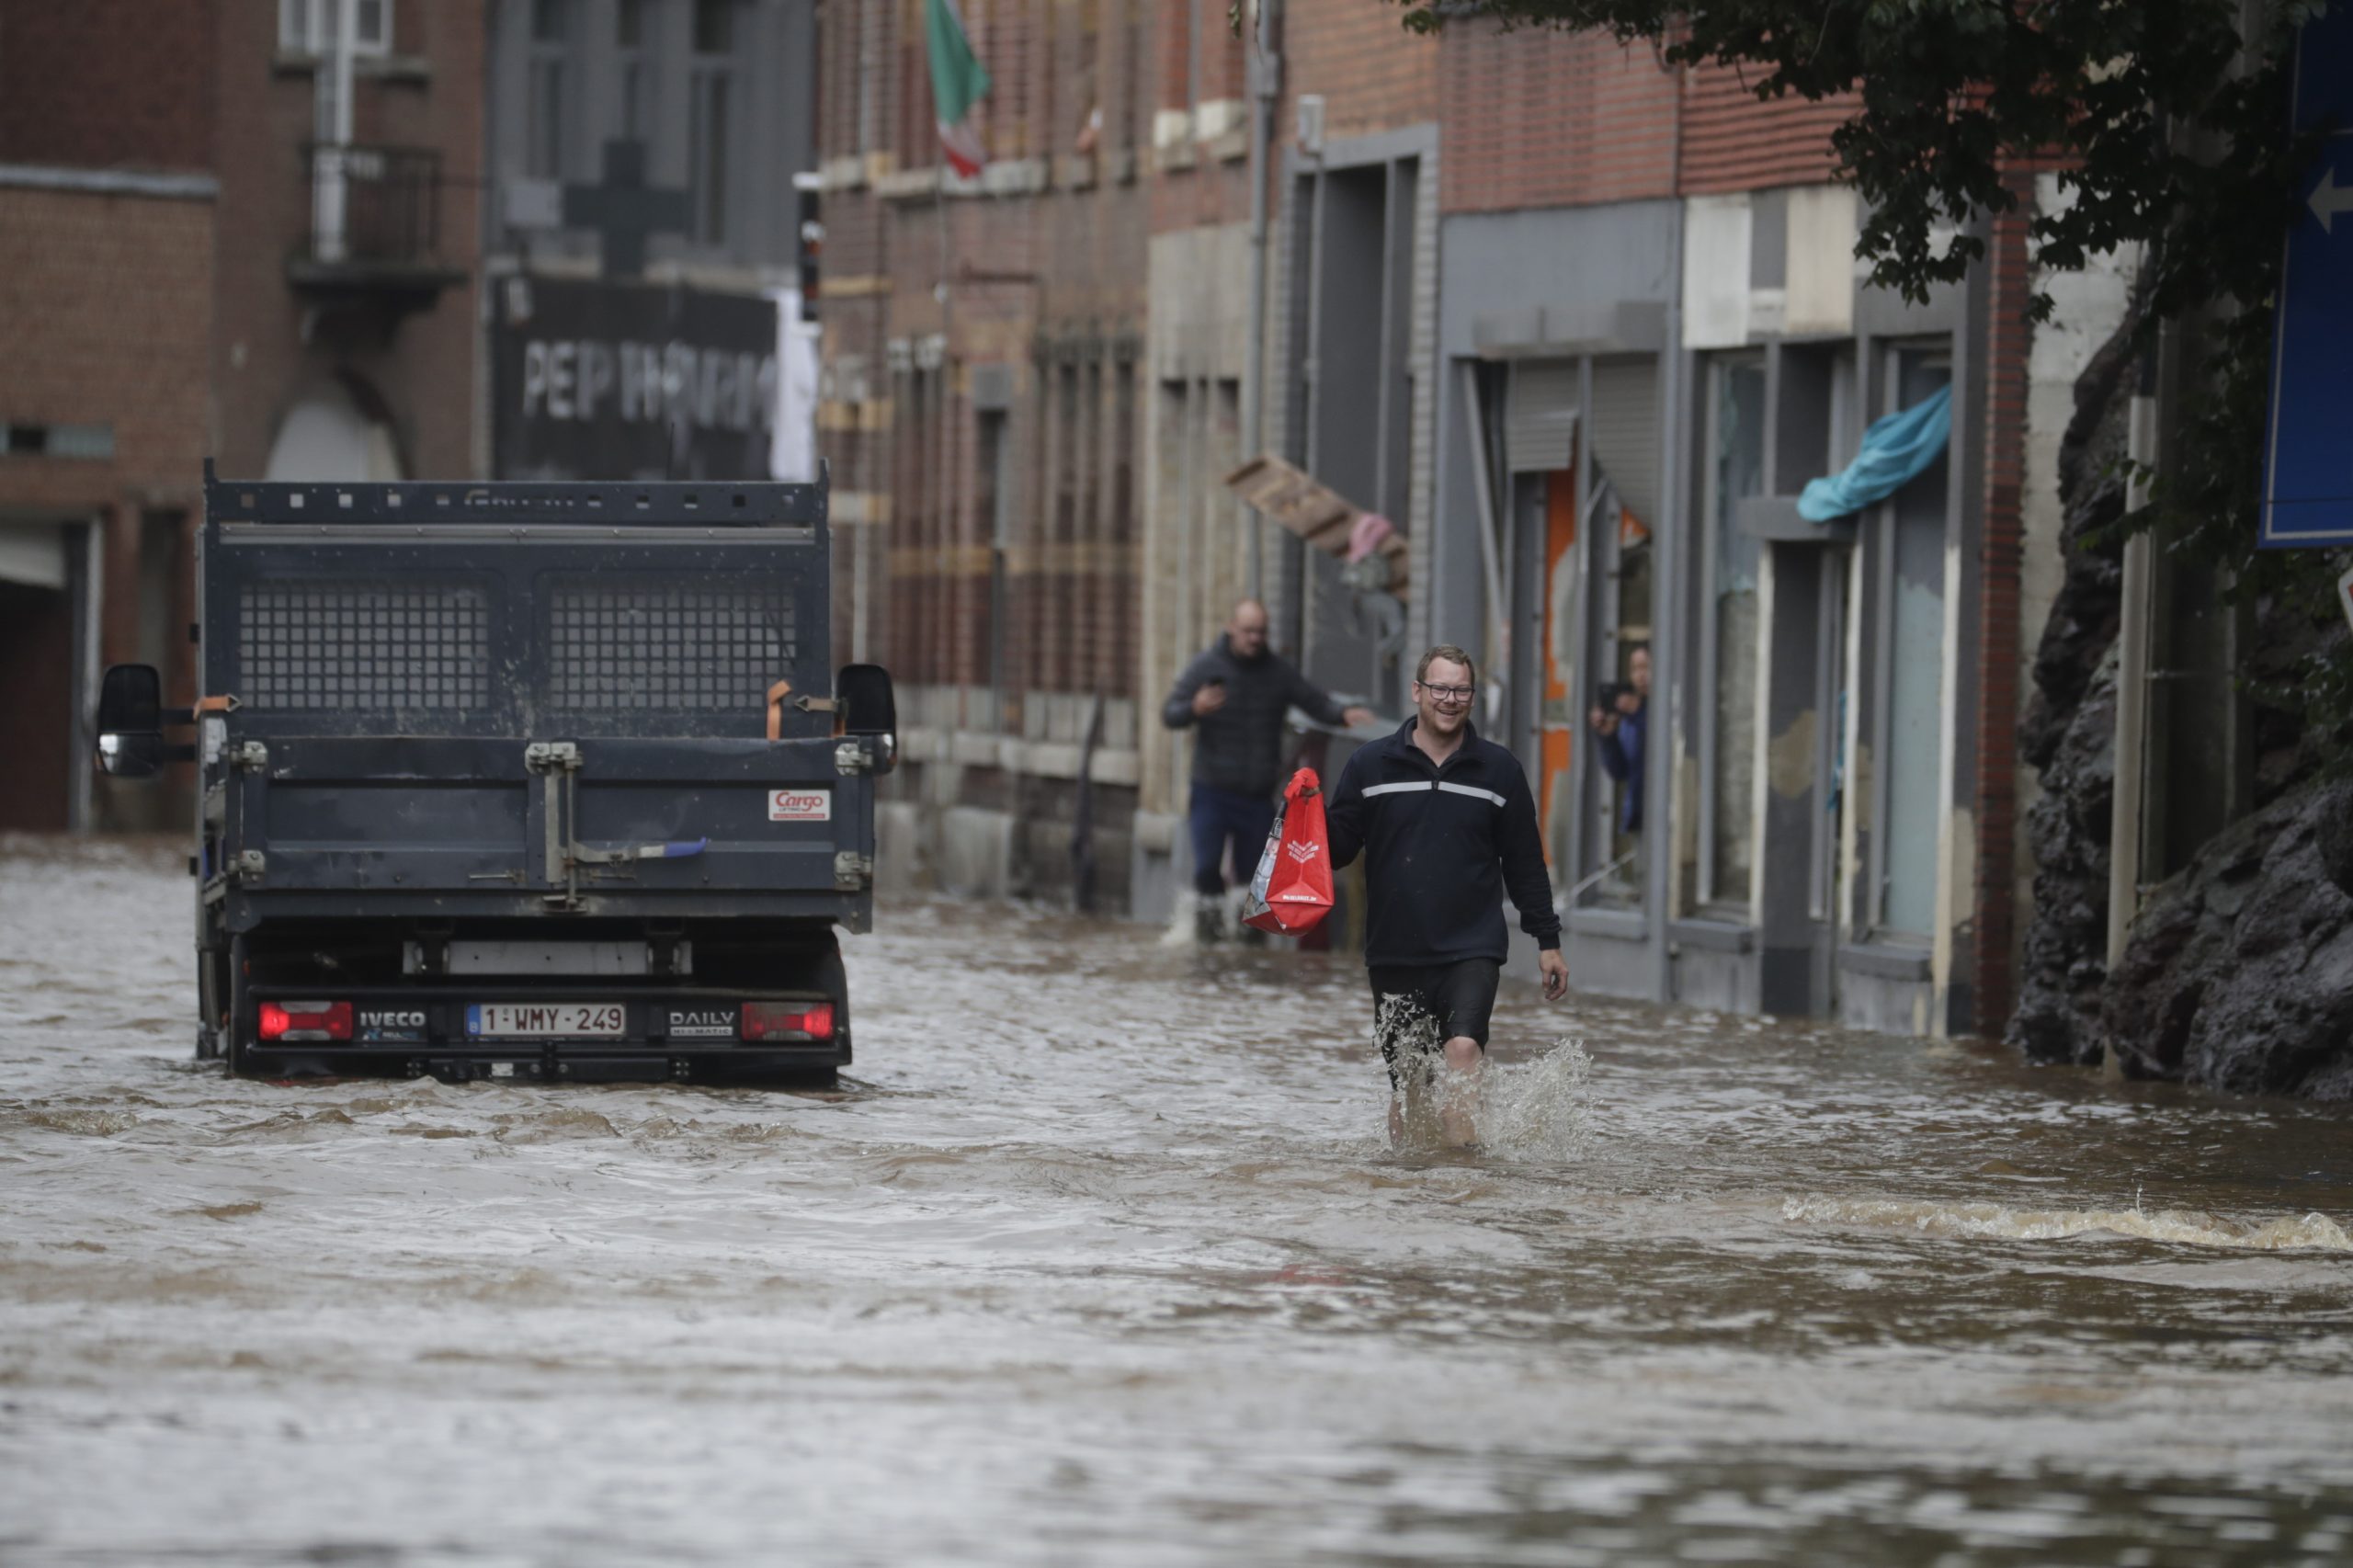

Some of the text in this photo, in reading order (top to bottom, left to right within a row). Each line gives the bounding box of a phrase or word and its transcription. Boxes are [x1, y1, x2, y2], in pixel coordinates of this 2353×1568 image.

[776, 791, 824, 812] Cargo
[359, 1011, 426, 1028] IVECO
[669, 1011, 735, 1025] DAILY
